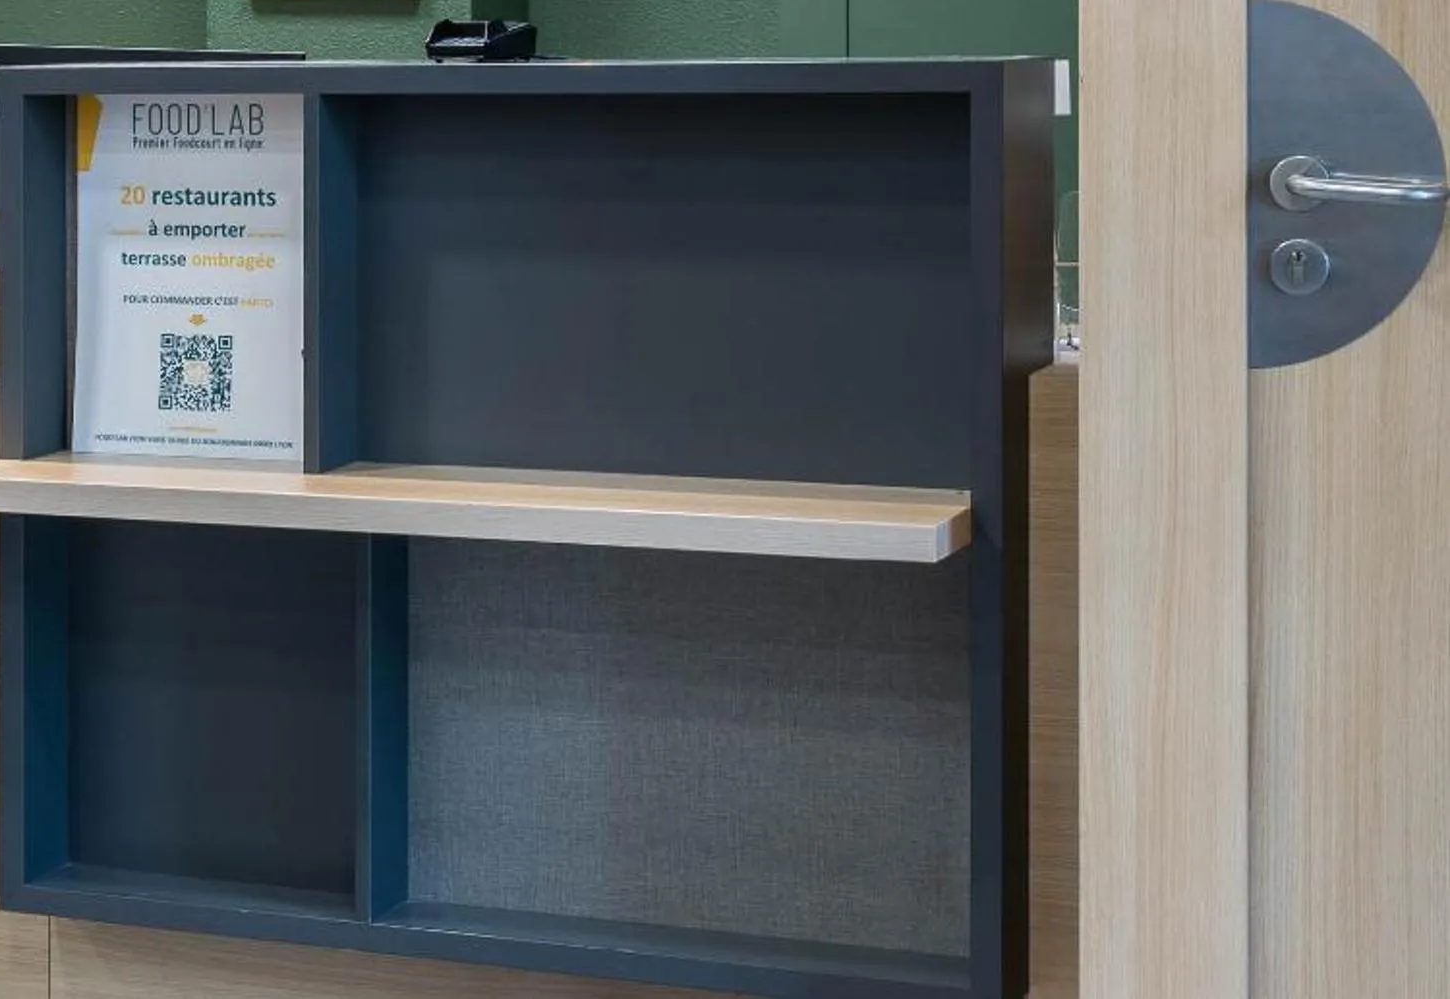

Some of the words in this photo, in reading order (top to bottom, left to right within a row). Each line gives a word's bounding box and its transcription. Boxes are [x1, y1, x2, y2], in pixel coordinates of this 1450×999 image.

[132, 103, 265, 136] FOOD'LAB
[133, 136, 170, 149] Premier
[173, 137, 222, 150] Foodcourt
[224, 139, 235, 149] en
[239, 138, 265, 153] ligne
[120, 185, 146, 206] 20
[152, 187, 278, 208] restaurants
[148, 220, 158, 238] à
[163, 222, 247, 241] emporter
[122, 252, 187, 268] terrasse
[192, 252, 277, 273] ombragée
[123, 294, 149, 305] POUR
